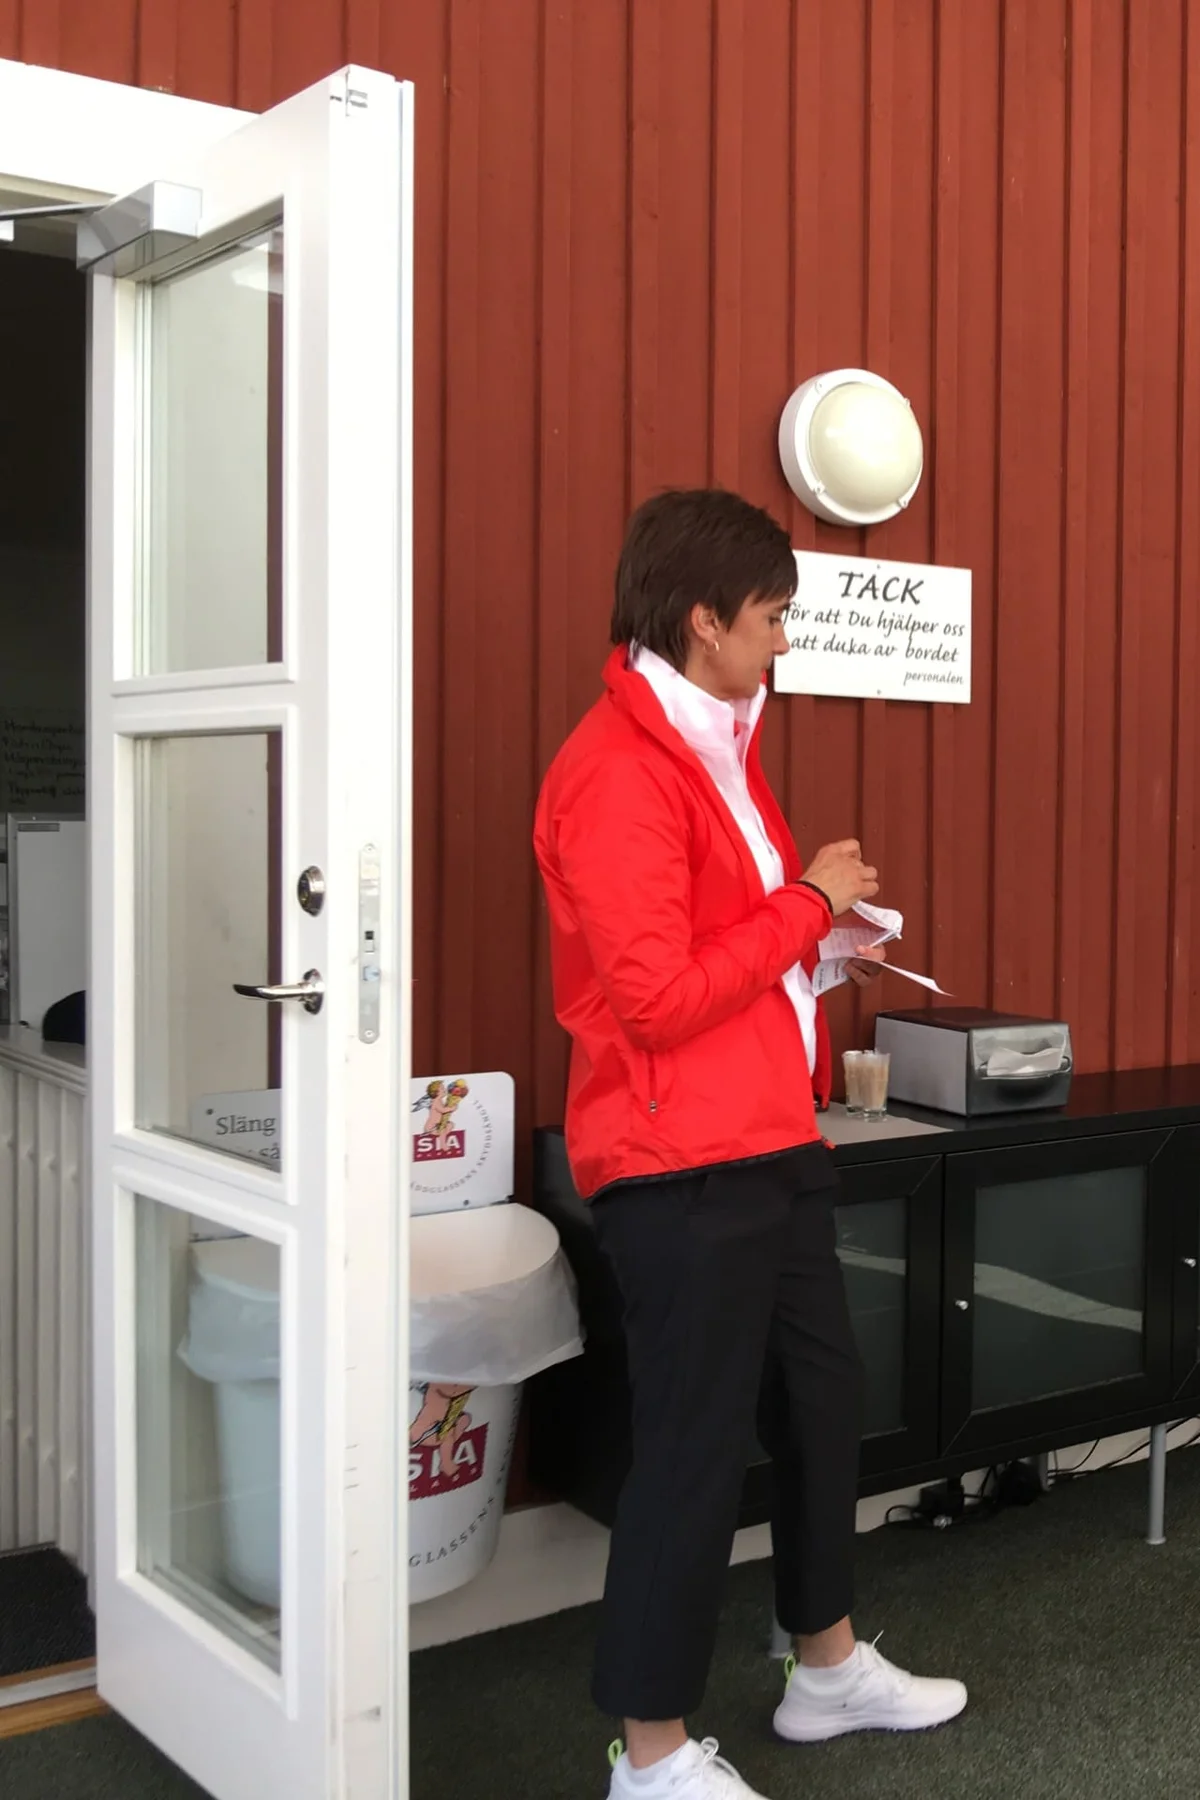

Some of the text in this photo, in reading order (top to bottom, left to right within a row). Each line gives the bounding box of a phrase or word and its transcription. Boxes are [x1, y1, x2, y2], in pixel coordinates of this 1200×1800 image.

[838, 571, 924, 605] TACK
[814, 608, 842, 625] att
[848, 610, 875, 628] Du
[877, 609, 939, 640] hjälper
[943, 623, 965, 637] oss
[791, 633, 960, 663] att duka av bordet
[903, 670, 965, 687] personalen
[216, 1114, 276, 1137] Släng
[417, 1135, 460, 1153] SIA
